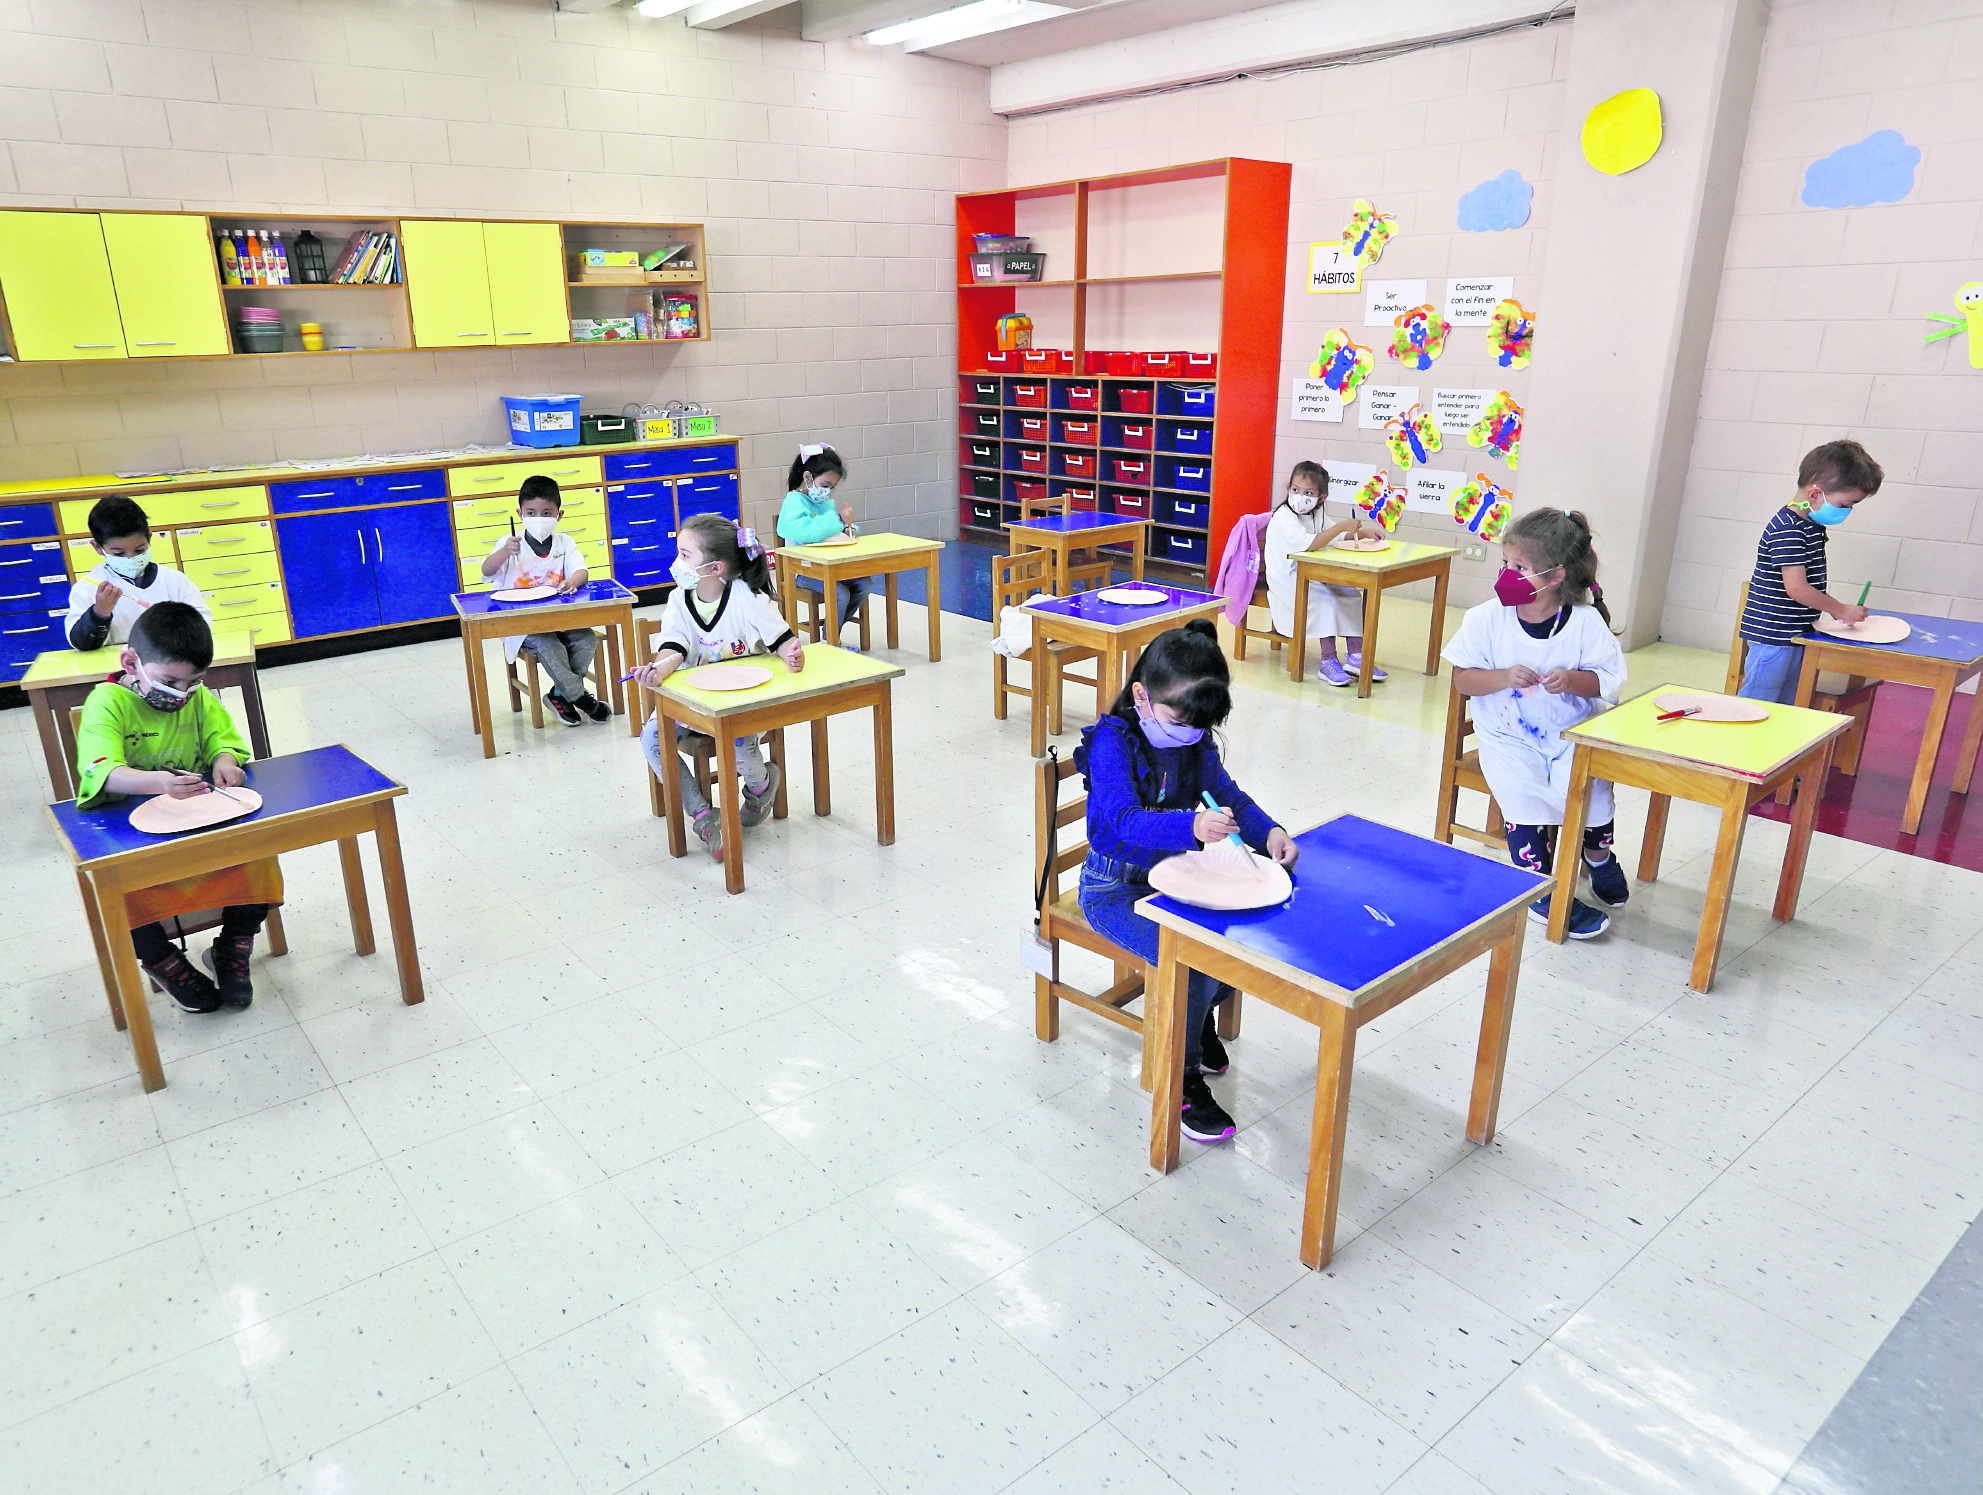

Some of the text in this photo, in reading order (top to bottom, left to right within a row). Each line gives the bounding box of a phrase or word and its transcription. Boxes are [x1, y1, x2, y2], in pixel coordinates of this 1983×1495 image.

[1333, 252, 1339, 264] 7
[1011, 261, 1032, 270] PAPEL
[1313, 271, 1356, 285] HÁBITOS
[1455, 283, 1493, 291] Comenzar
[1385, 292, 1397, 300] Ser
[1465, 296, 1472, 304] el
[1473, 296, 1484, 304] fin
[1374, 304, 1407, 313] Proactivo
[1454, 309, 1488, 317] la mente
[1305, 383, 1325, 391] Poner
[1372, 389, 1397, 398] Pensar
[1298, 395, 1323, 403] primero
[1300, 406, 1326, 414] primero
[1370, 402, 1392, 410] Ganar
[1372, 414, 1393, 422] Ganar
[1444, 412, 1459, 420] luego
[647, 423, 671, 434] Mesa 1
[690, 420, 712, 432] Mesa 2
[1417, 480, 1446, 490] Afilar la
[1418, 493, 1441, 501] sierra
